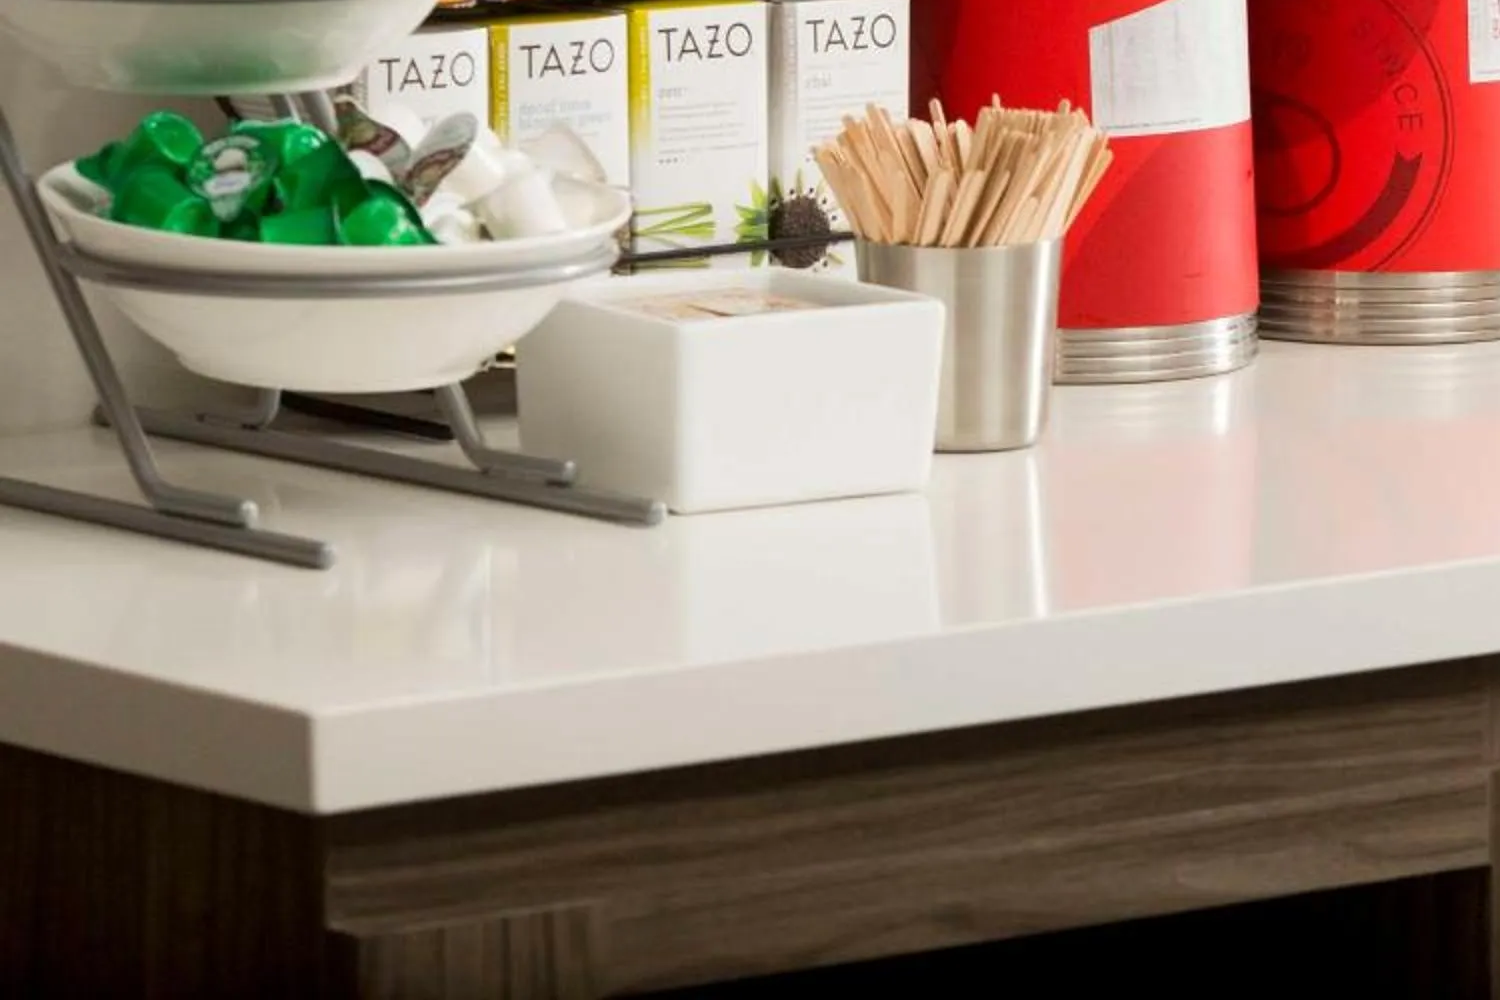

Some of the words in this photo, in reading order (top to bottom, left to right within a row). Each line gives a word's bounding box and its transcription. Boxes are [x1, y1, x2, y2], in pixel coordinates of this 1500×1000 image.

[657, 22, 753, 62] TAZO
[804, 13, 897, 53] TAZO
[377, 50, 476, 93] TAZO
[518, 37, 615, 79] TAZO
